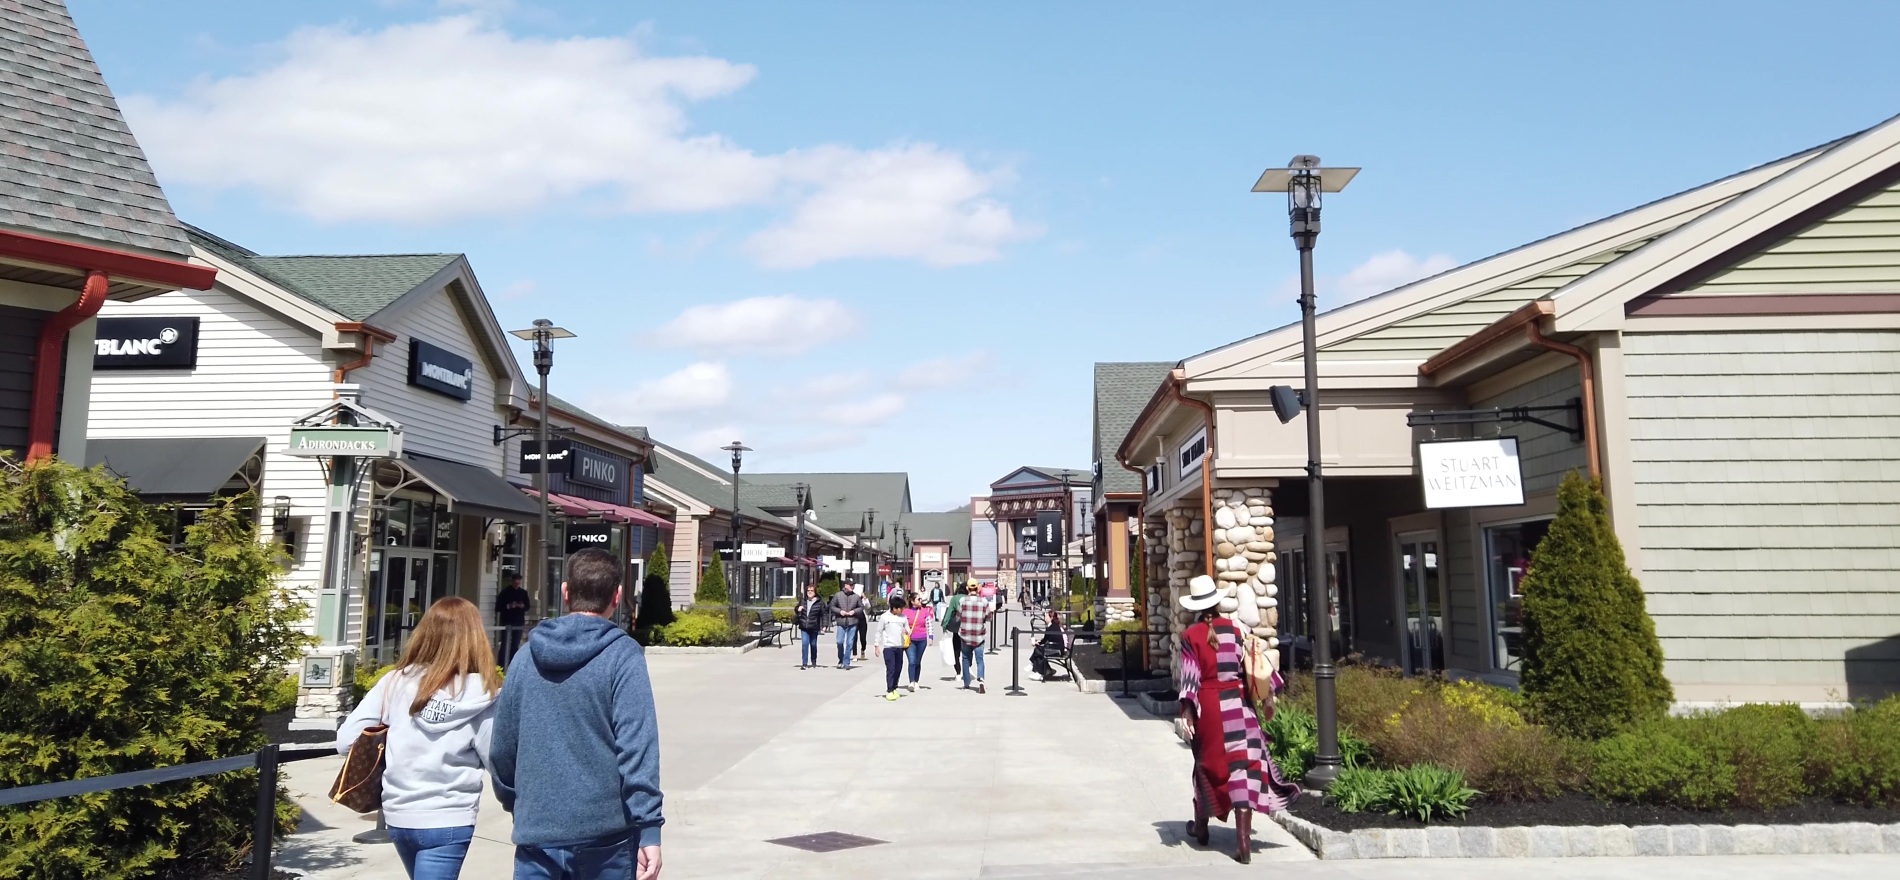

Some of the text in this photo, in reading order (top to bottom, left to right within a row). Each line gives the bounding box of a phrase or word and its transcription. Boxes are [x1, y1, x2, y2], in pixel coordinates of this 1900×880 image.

[298, 436, 375, 450] ADIRONDACKS
[524, 453, 564, 461] MONLANC
[1441, 456, 1499, 473] STUART
[582, 456, 615, 483] PINKO
[1428, 474, 1516, 490] WEITZMAN
[570, 534, 608, 543] PINKO
[743, 549, 763, 557] DIOR
[430, 698, 455, 715] TANY
